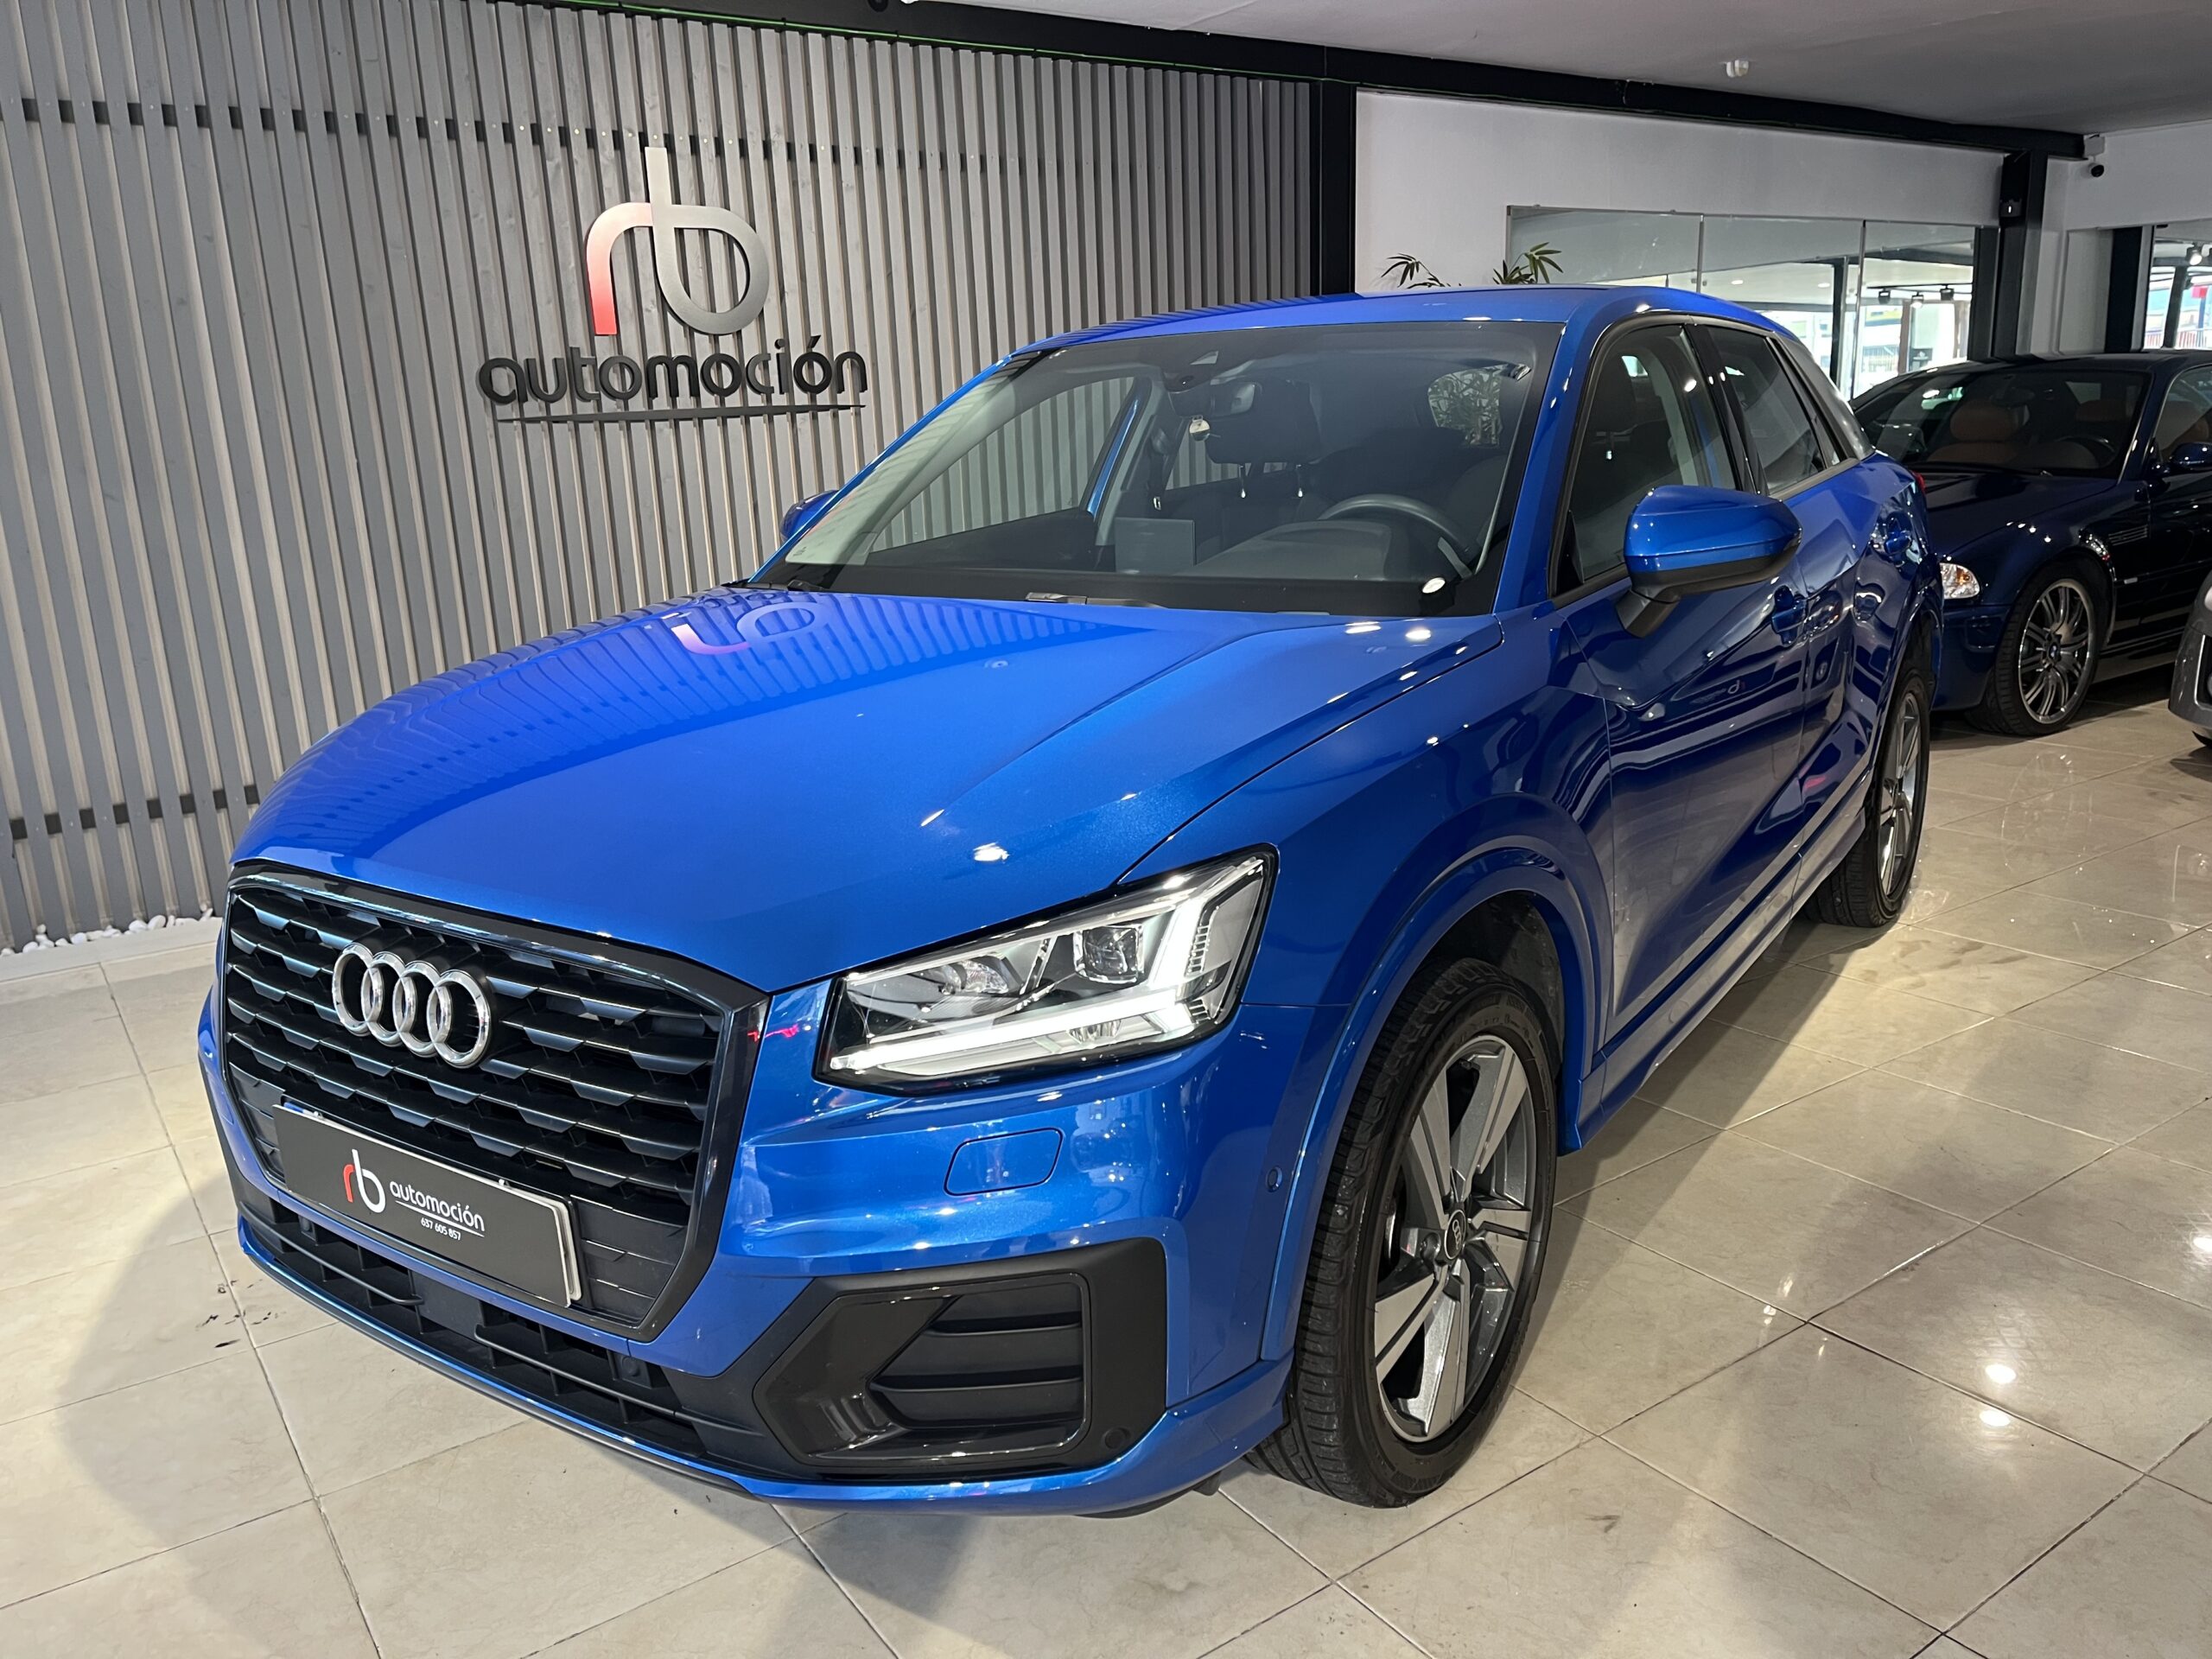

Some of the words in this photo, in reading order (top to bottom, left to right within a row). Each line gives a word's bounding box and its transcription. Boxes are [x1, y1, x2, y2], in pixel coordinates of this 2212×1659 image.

[478, 334, 868, 404] automoción
[343, 1148, 386, 1213] rb
[389, 1180, 486, 1232] automoción
[435, 1223, 448, 1236] 605
[448, 1228, 461, 1241] 857
